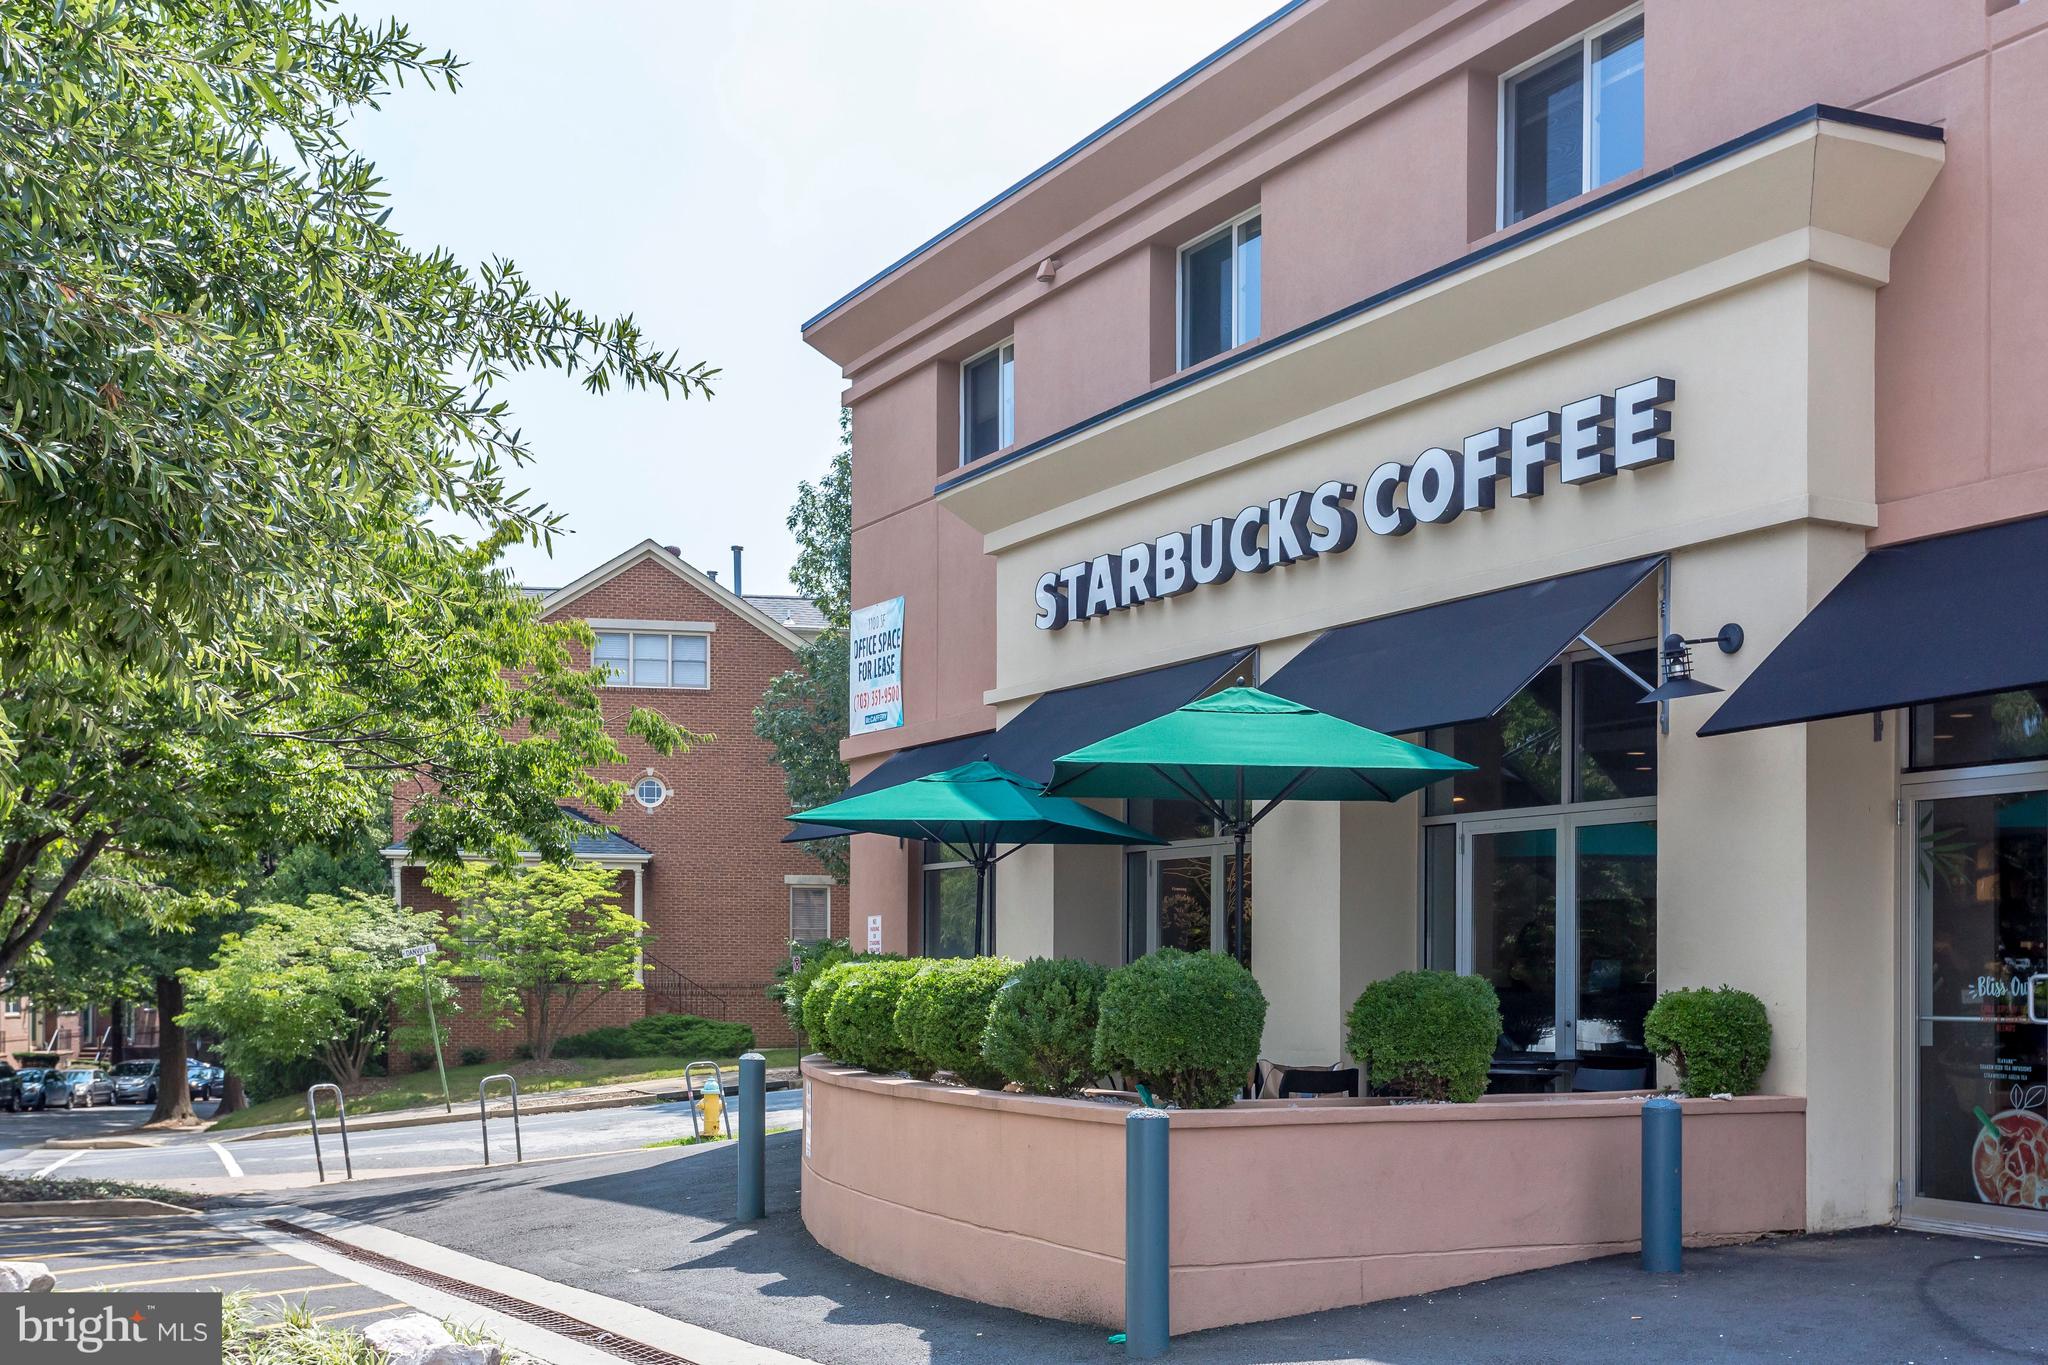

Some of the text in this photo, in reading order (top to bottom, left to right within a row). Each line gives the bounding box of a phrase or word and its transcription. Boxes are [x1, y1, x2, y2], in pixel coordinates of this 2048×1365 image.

[1035, 376, 1675, 630] STARBUCKS COFFEE
[854, 627, 901, 659] OFFICE SPACE
[858, 653, 895, 682] FOR LEASE
[854, 684, 900, 712] (703) 351-9500
[1978, 976, 2032, 997] Bliss Ou
